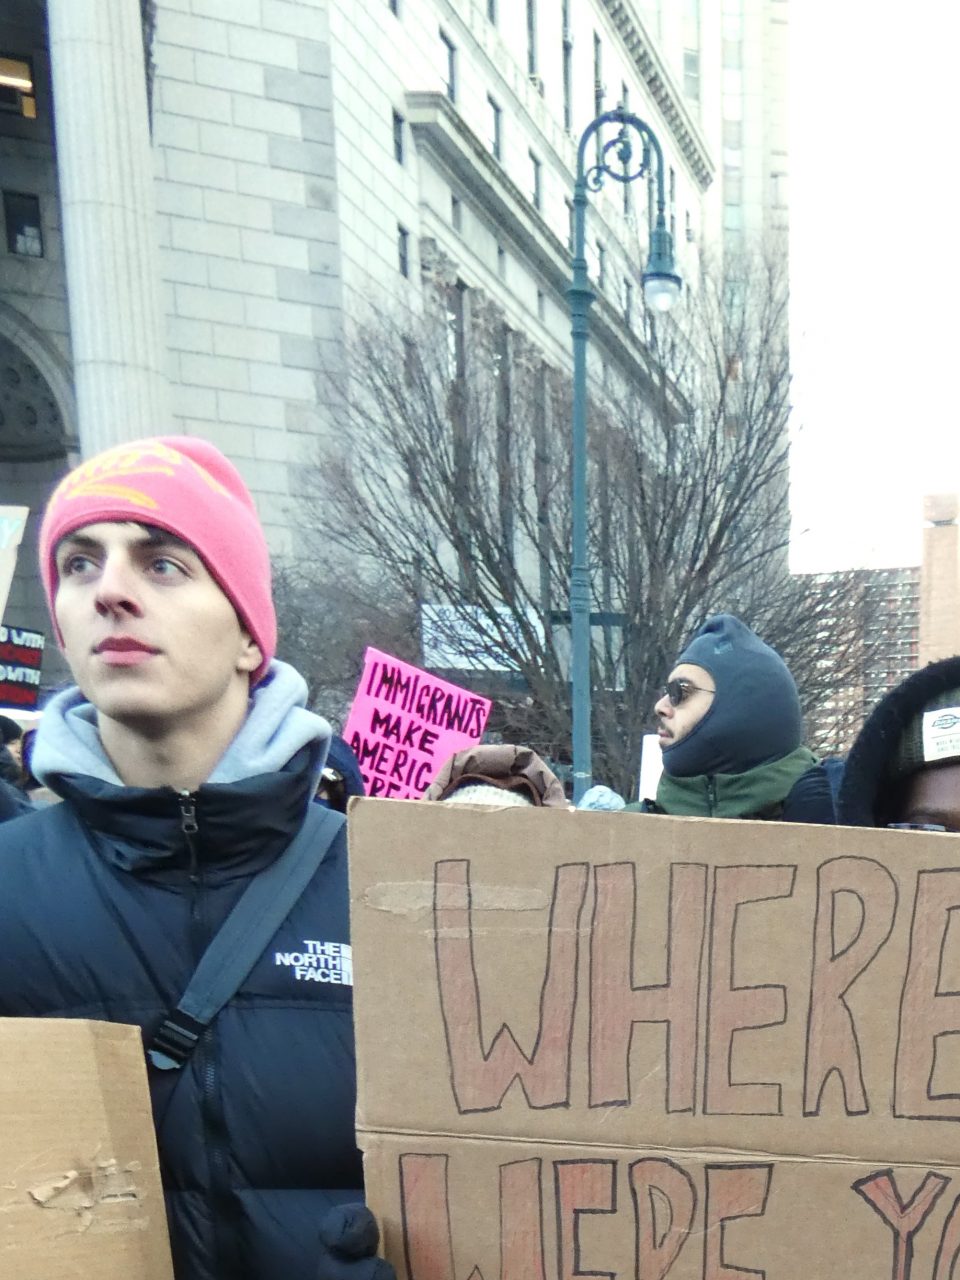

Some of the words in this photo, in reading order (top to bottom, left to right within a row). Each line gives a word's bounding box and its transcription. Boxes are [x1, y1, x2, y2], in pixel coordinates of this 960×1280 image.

[366, 662, 486, 739] IMMIGRANTS
[370, 707, 440, 757] MAKE
[350, 730, 433, 792] AMERIC
[275, 952, 342, 971] NORTH
[303, 940, 341, 957] THE
[295, 966, 342, 984] FACE
